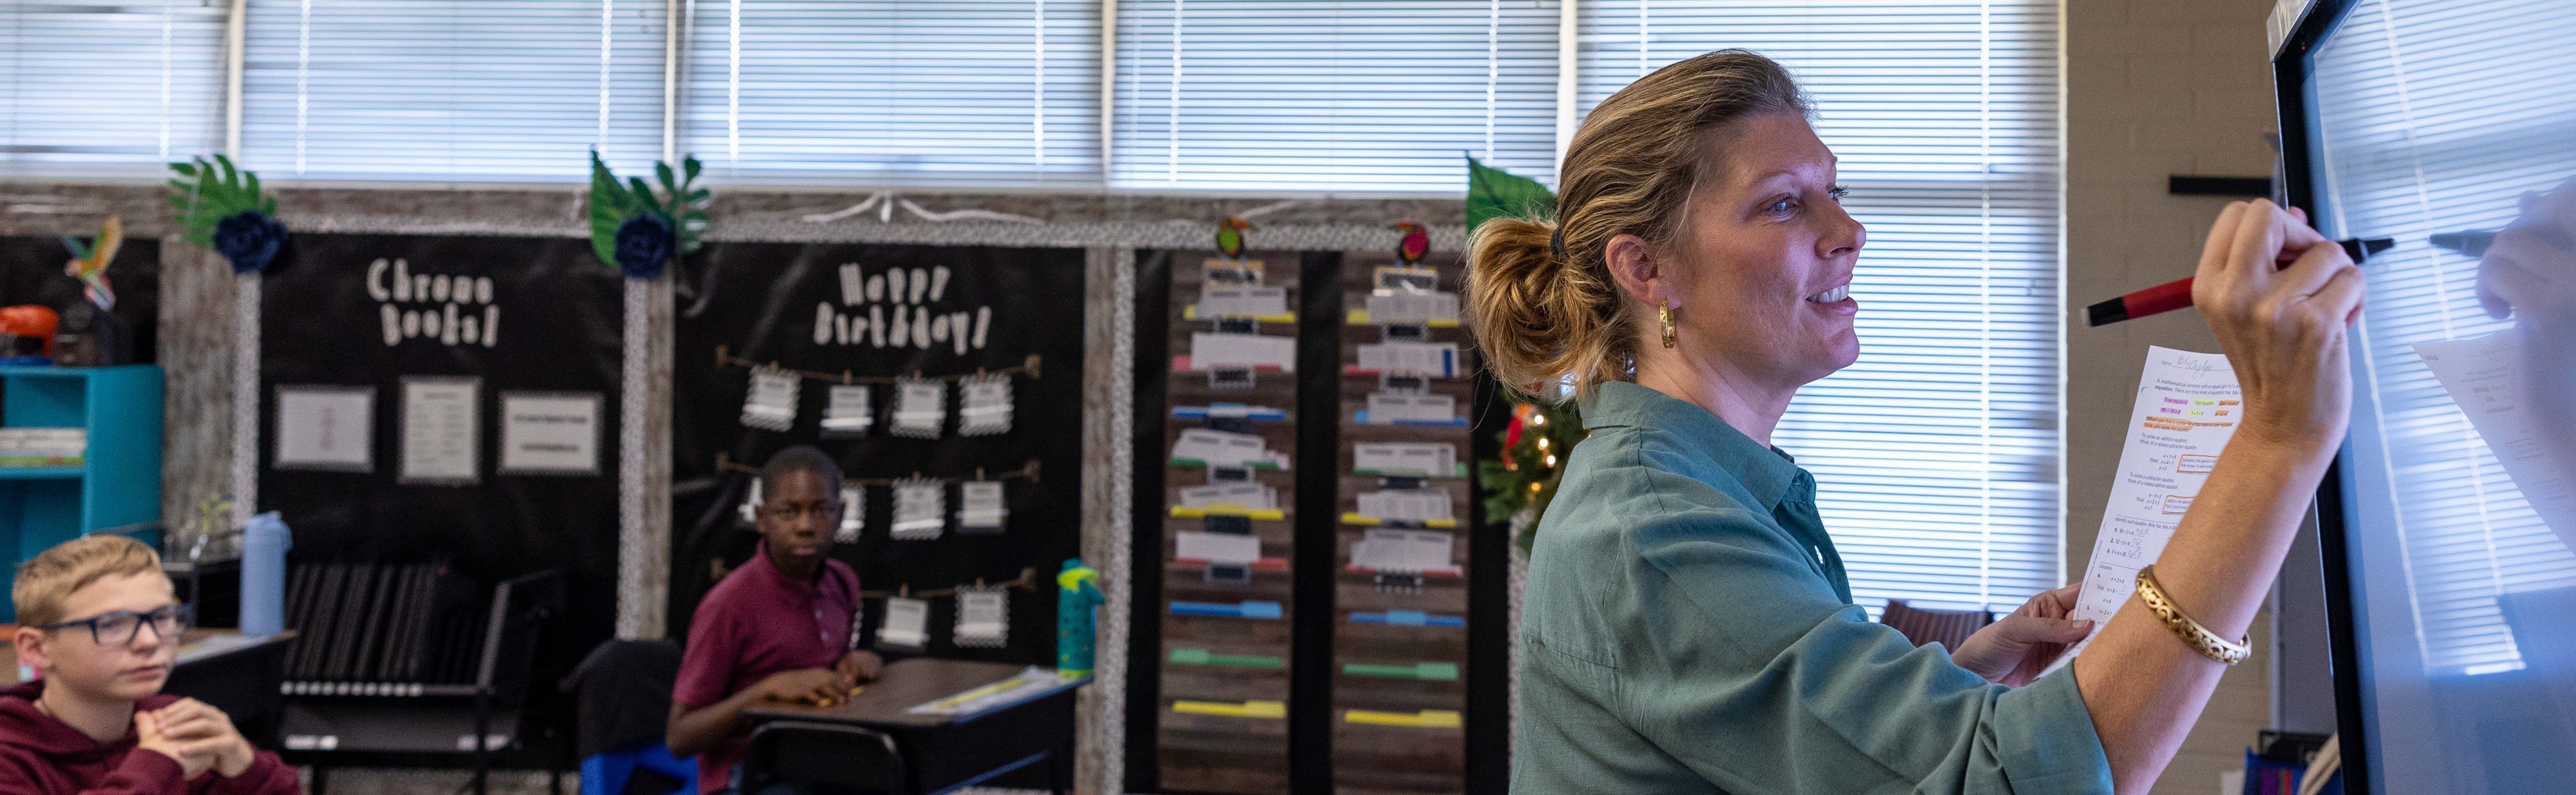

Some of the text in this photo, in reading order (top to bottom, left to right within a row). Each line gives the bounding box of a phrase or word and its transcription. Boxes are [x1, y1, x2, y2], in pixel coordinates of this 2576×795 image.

[367, 258, 494, 305] Chrome
[839, 263, 951, 306] Happy
[380, 302, 499, 348] Books!
[813, 301, 992, 356] Birthday!
